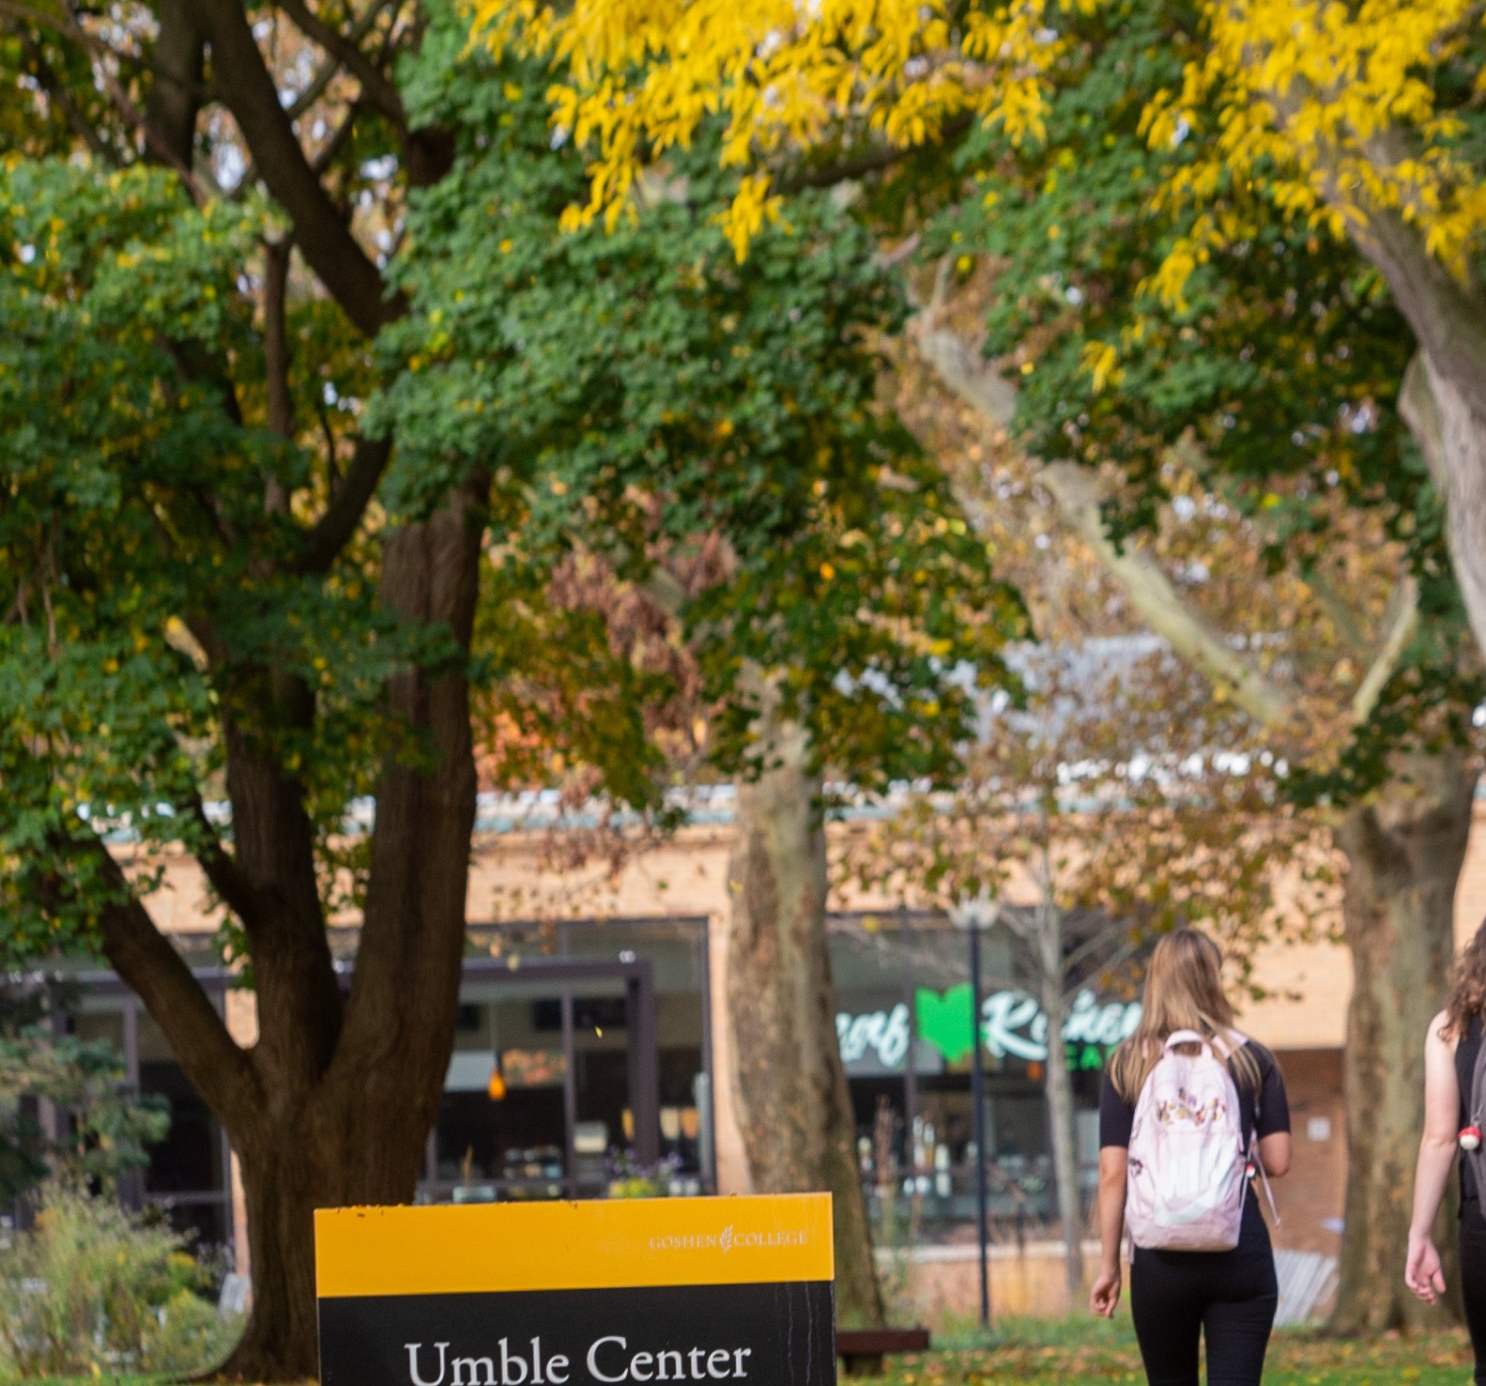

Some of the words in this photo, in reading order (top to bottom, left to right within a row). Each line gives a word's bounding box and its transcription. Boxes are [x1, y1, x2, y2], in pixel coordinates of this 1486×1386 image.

[648, 1234, 717, 1251] GOSHEN
[733, 1230, 808, 1247] COLLEGE
[586, 1335, 752, 1383] Center
